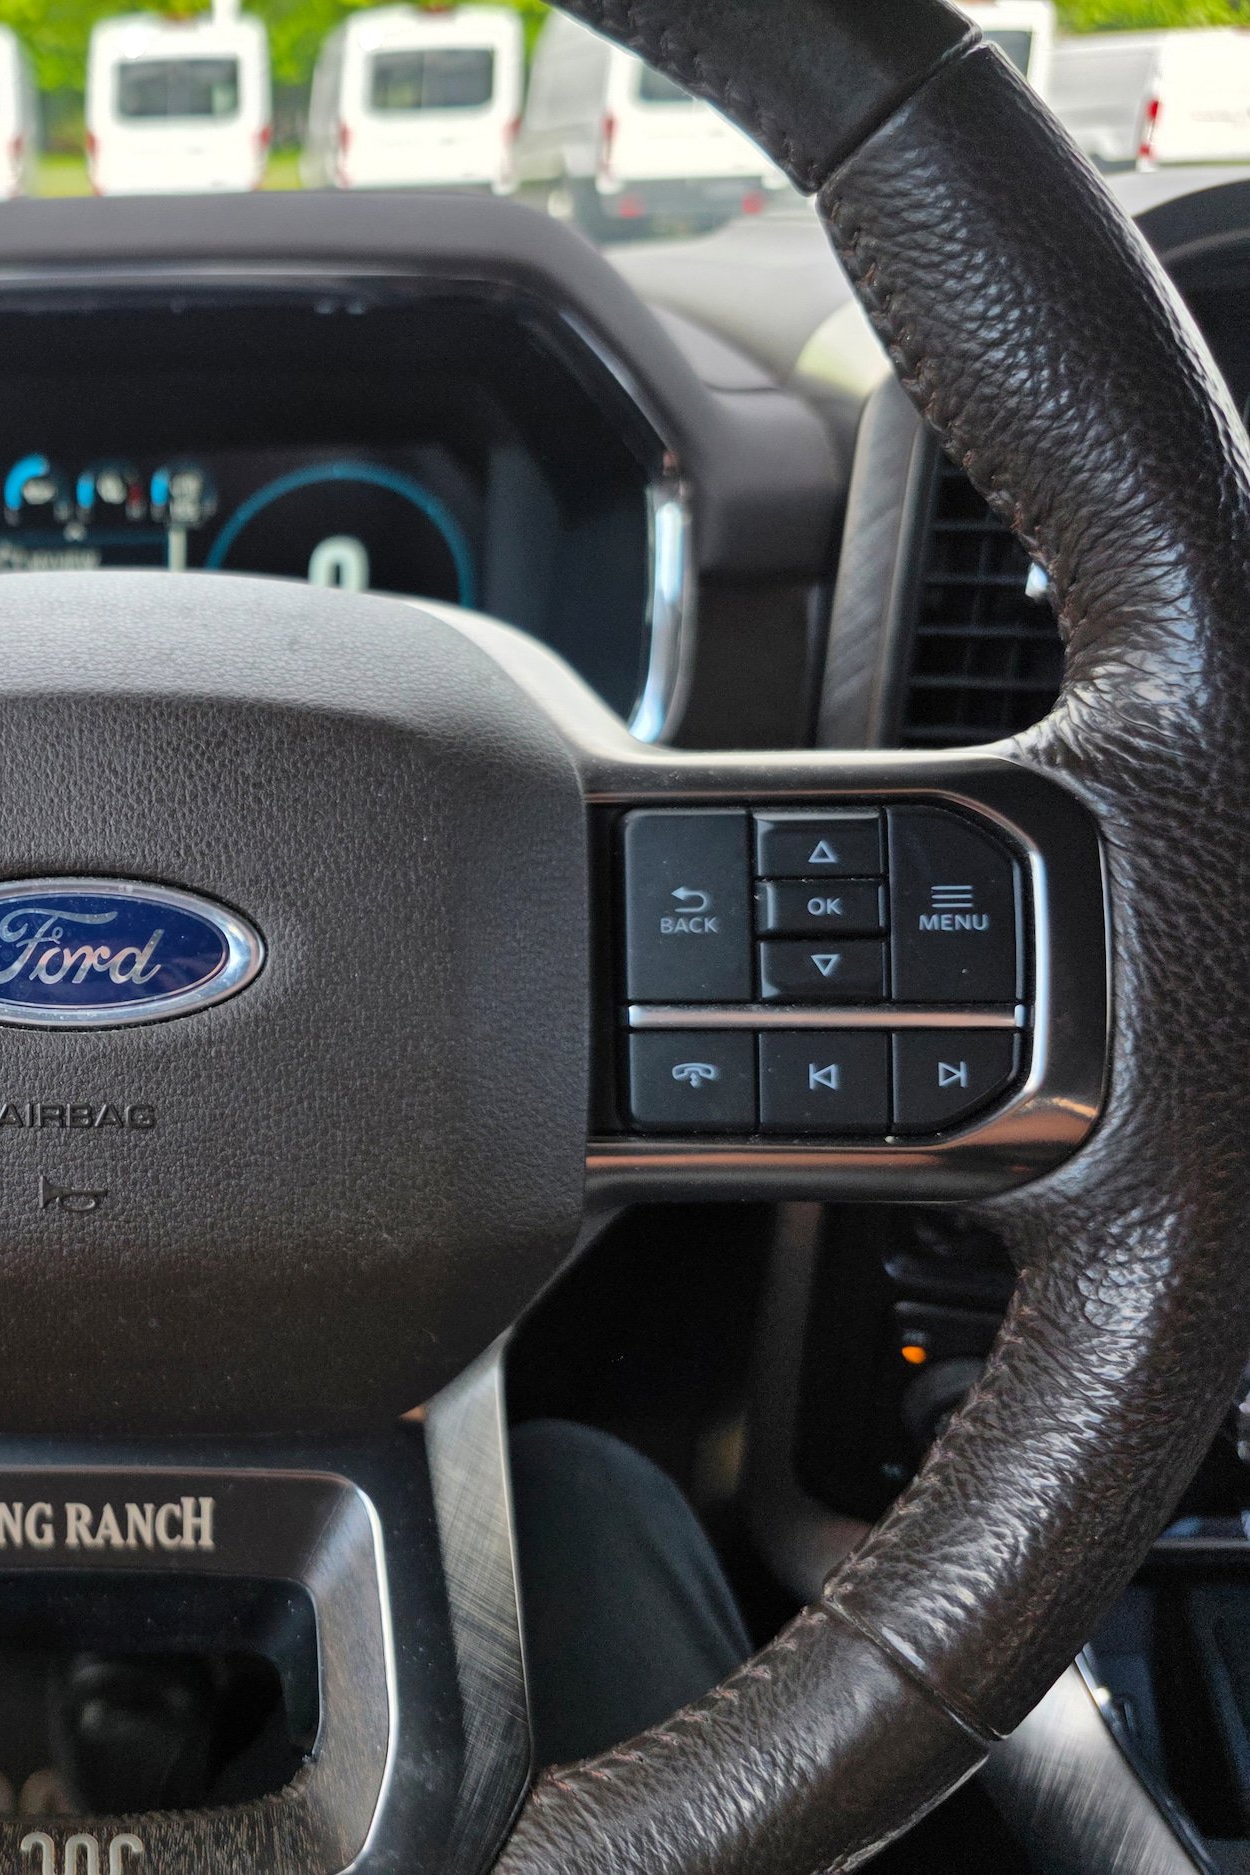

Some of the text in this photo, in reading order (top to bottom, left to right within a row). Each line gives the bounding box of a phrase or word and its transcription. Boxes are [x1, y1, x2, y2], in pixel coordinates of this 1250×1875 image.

[807, 897, 841, 916] OK
[659, 917, 718, 934] BACK
[918, 914, 989, 931] MENU
[64, 1495, 215, 1551] RANCH
